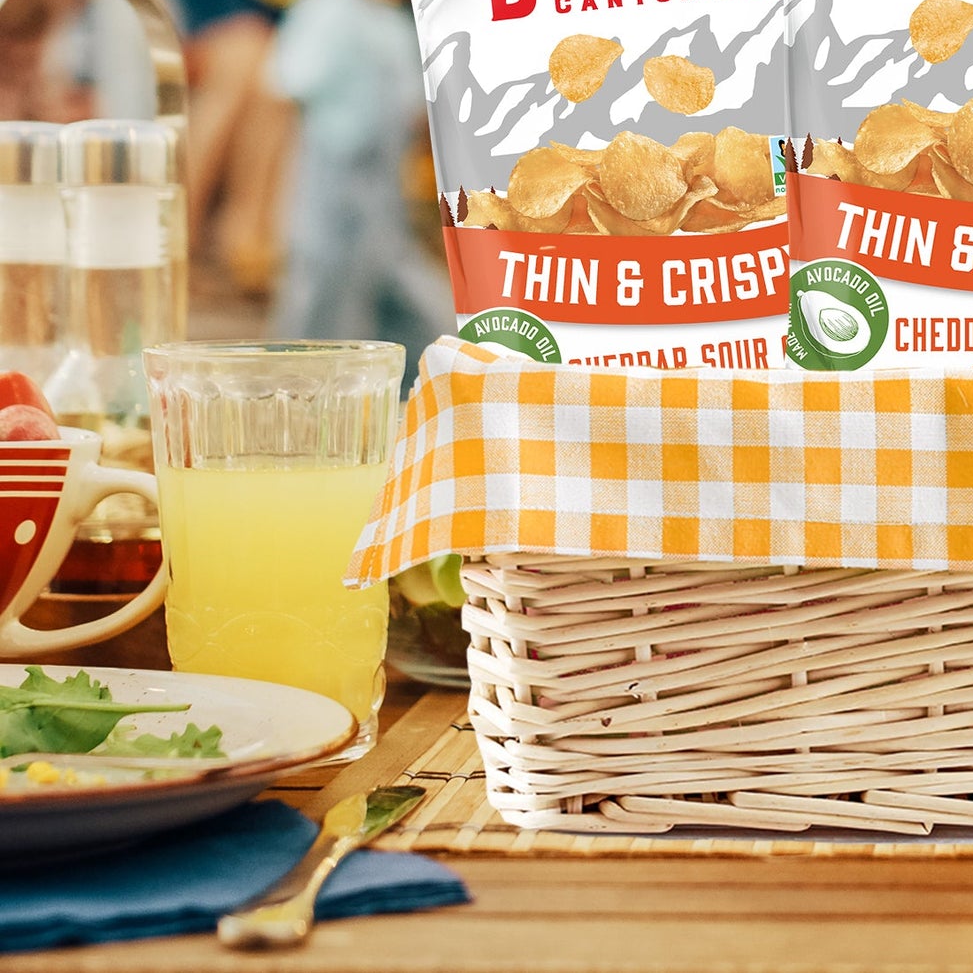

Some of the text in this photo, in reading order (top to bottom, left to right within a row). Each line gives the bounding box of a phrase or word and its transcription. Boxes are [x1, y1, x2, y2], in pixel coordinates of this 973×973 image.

[836, 201, 938, 267] THIN
[498, 244, 789, 307] THIN & CRISP
[806, 266, 885, 318] AVOCADO OIL
[473, 315, 539, 341] AVOCADO
[535, 336, 557, 362] OIL
